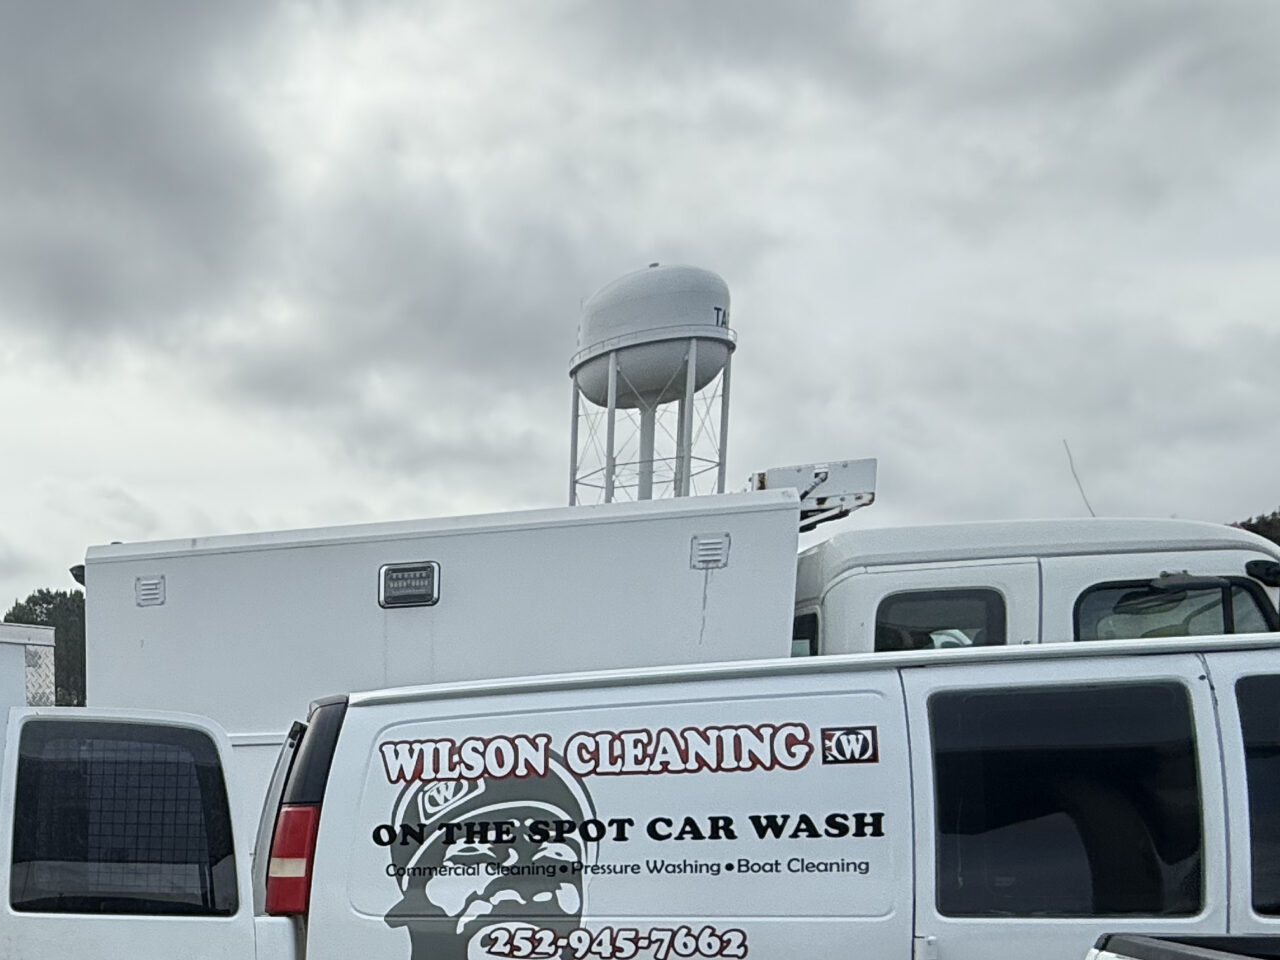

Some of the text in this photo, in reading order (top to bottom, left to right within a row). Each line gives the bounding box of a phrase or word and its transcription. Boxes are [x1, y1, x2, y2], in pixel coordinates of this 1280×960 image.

[380, 723, 815, 784] WILSON CLEANING
[372, 812, 885, 846] ON THE SPOT CAR WASH
[385, 857, 870, 878] Commercial Cleaning Pressure Washing Boat Cleaning
